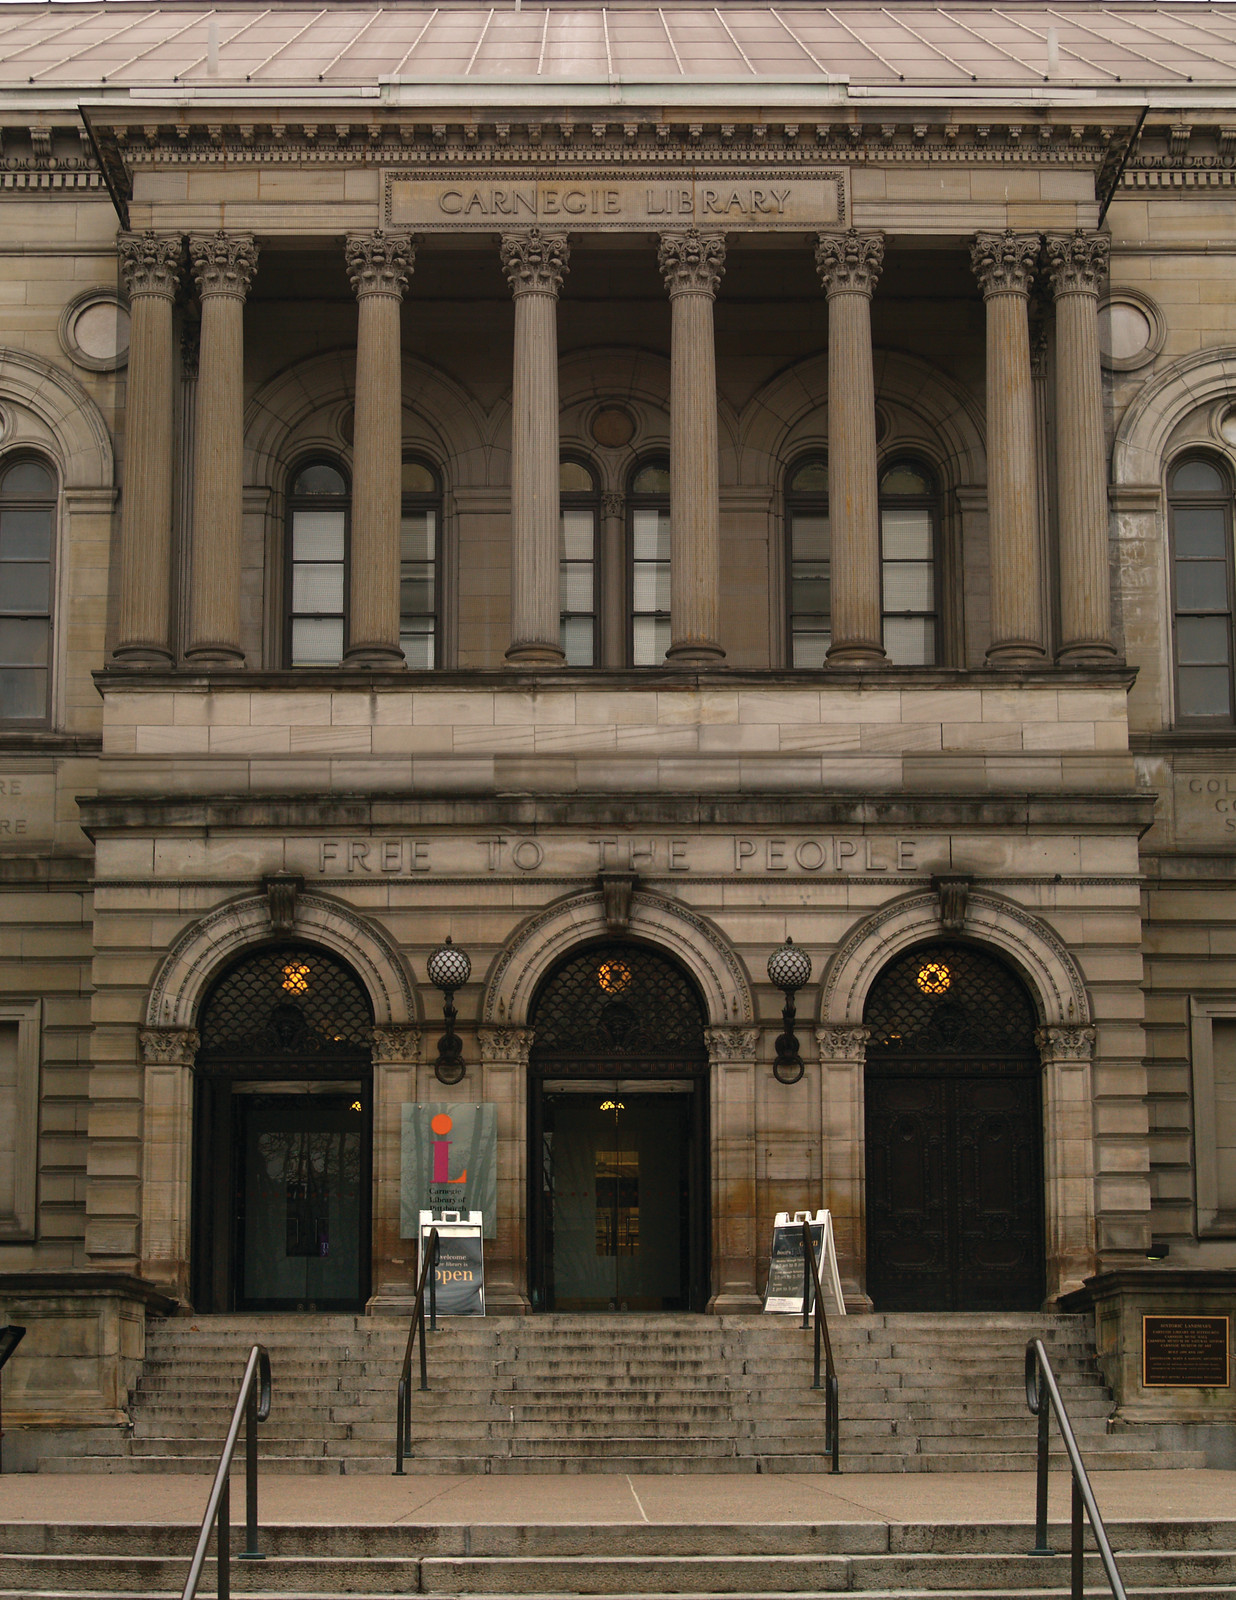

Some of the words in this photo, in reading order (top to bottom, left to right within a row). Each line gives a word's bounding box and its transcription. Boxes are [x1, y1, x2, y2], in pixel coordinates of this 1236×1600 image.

[439, 189, 622, 215] CARNEGIE
[646, 189, 791, 214] LIBRARY
[318, 839, 431, 873] FREE
[476, 839, 545, 871] TO
[587, 839, 690, 872] THE
[734, 839, 917, 872] PEOPLE
[429, 1196, 456, 1204] Library
